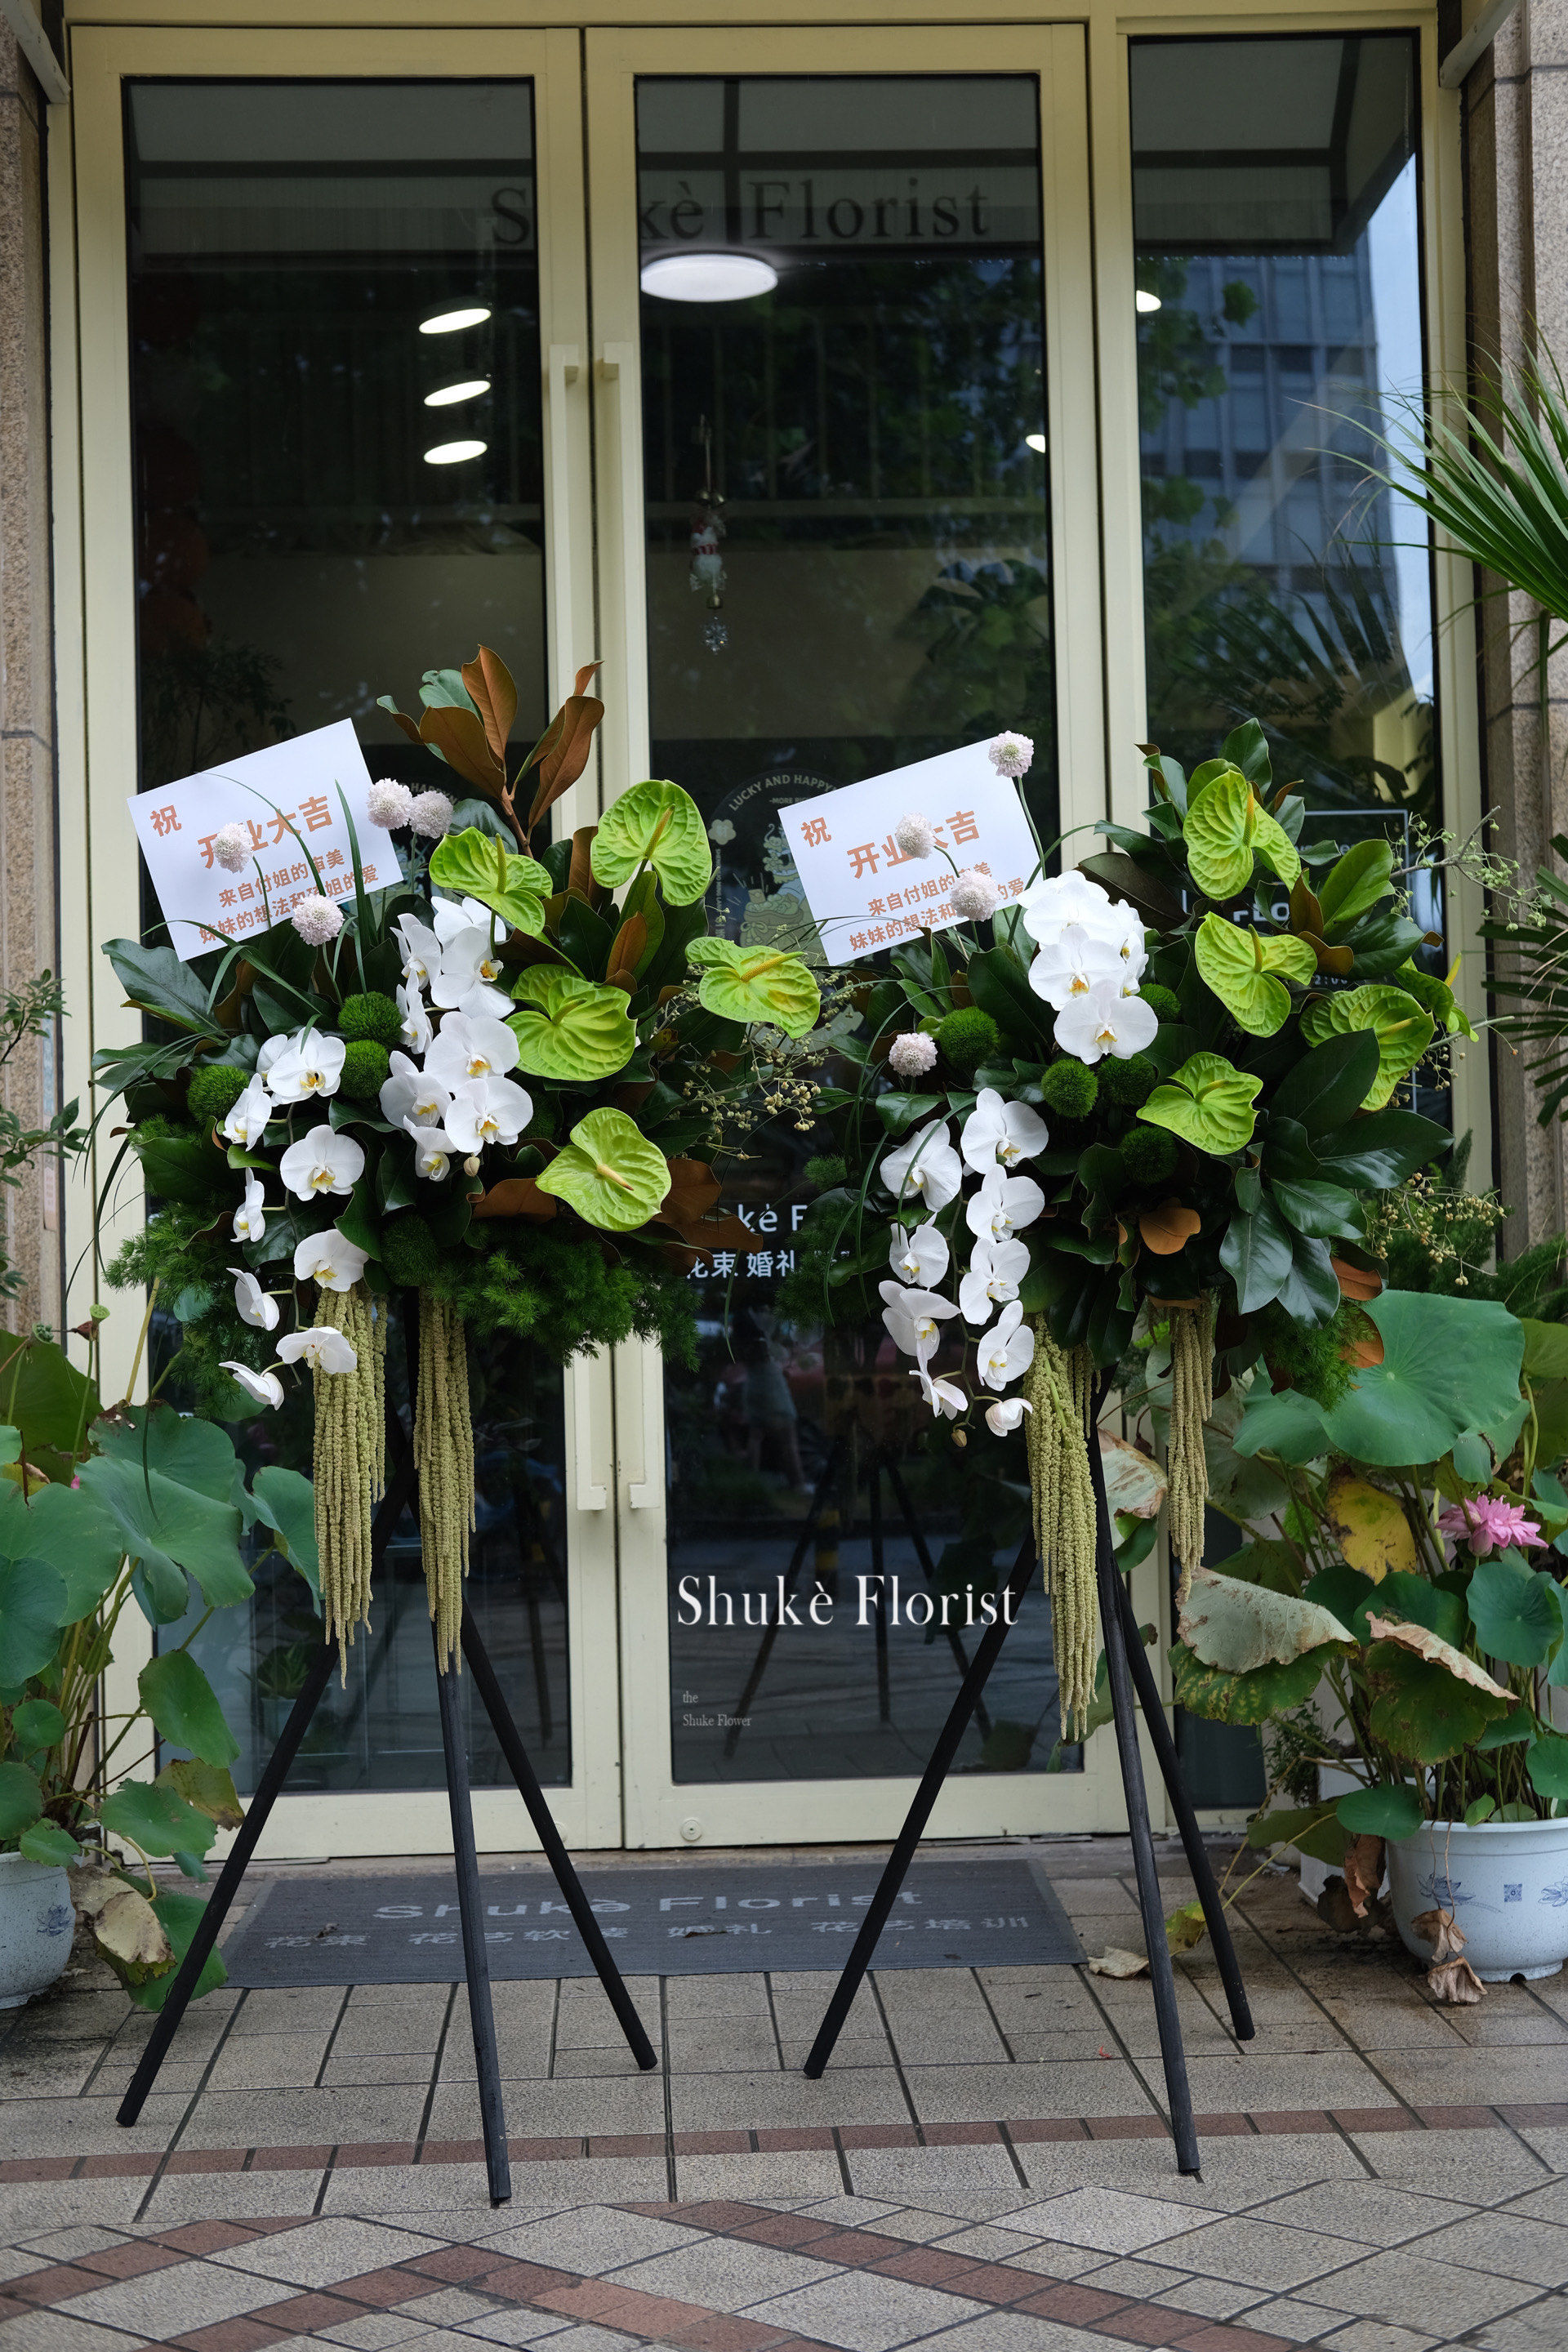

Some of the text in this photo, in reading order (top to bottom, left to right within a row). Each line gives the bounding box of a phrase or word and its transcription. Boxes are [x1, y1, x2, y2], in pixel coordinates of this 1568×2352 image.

[747, 177, 991, 239] Florist
[728, 781, 764, 812] LUCKY
[765, 774, 791, 791] AND
[150, 804, 182, 837] 祝
[800, 817, 832, 848] 祝
[846, 810, 980, 880] 开业吉
[198, 864, 380, 945] 妹妹的想法和姐的爱
[867, 862, 992, 916] 来自付姐的美
[677, 1575, 1019, 1626] Shukè Florist
[682, 1690, 699, 1704] the
[682, 1714, 752, 1728] Shuke Flower
[658, 1891, 923, 1913] Florist
